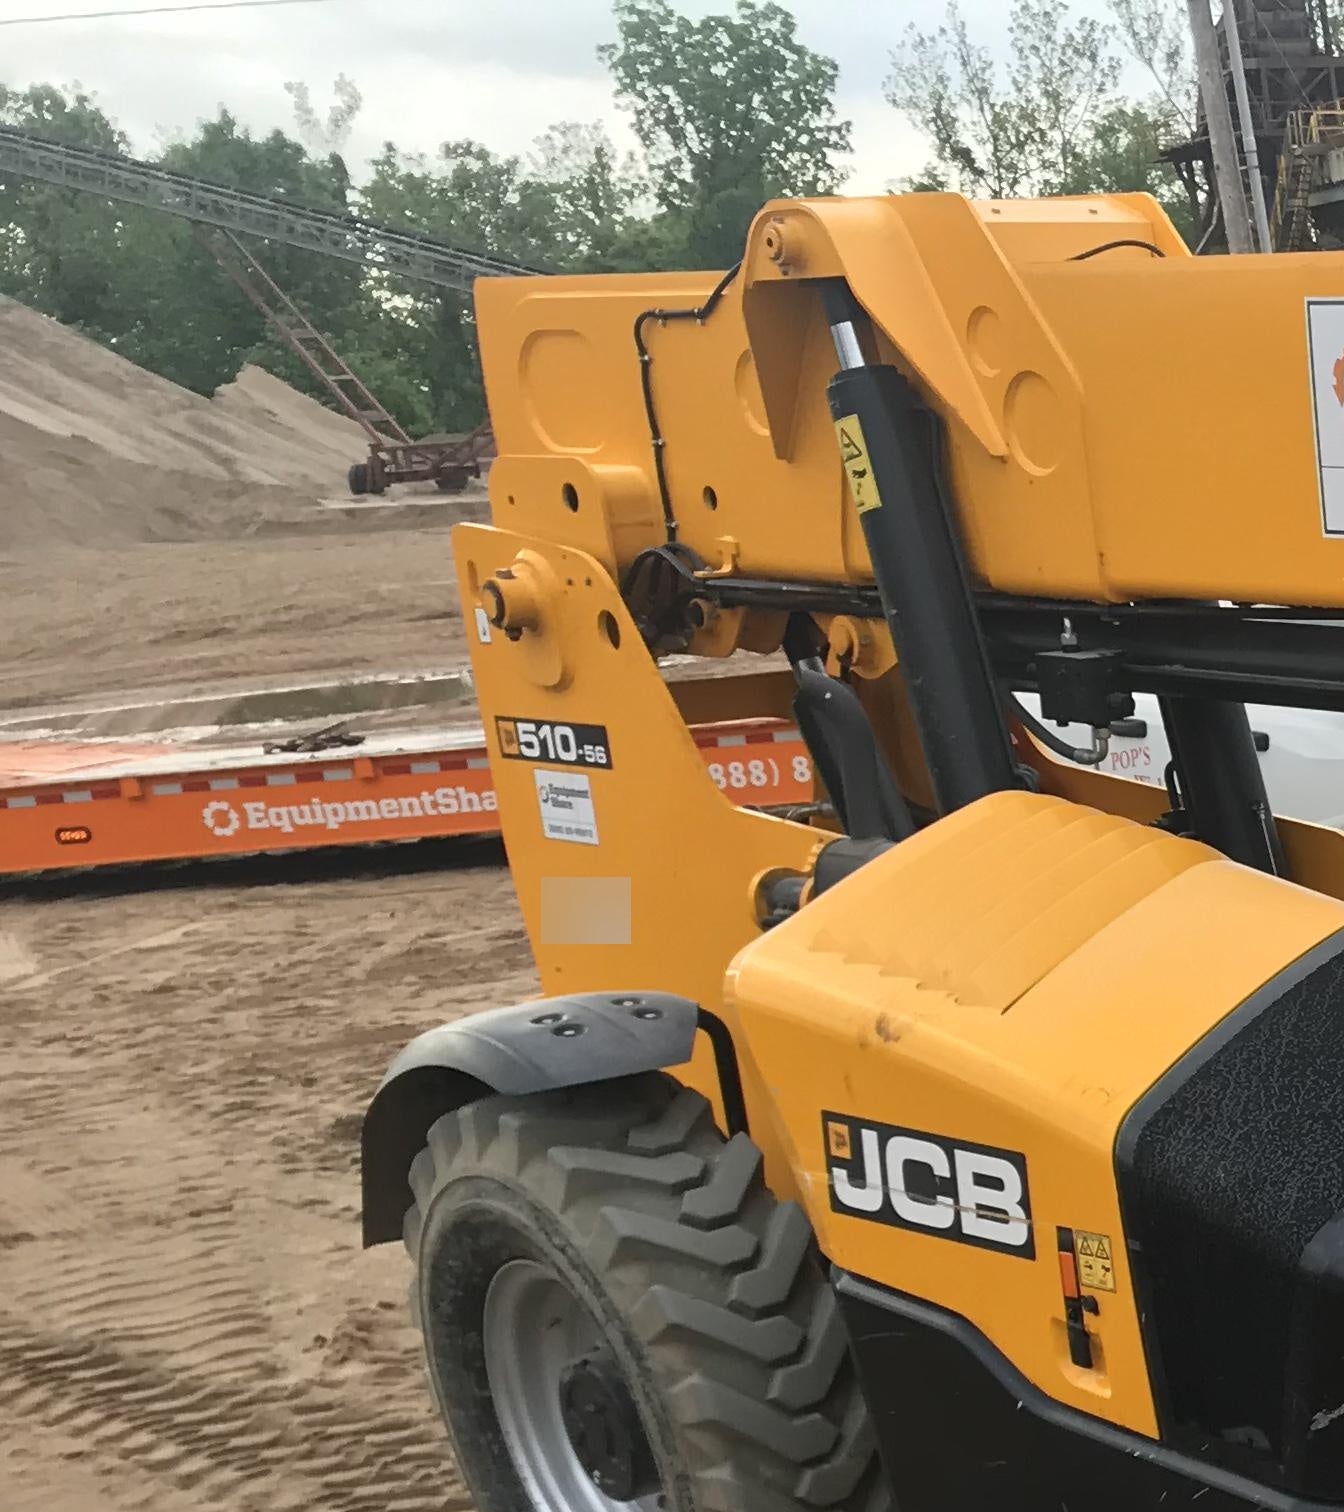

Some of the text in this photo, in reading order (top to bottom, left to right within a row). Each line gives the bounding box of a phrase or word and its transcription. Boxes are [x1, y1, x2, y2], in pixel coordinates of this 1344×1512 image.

[1110, 746, 1151, 771] POP'S
[243, 786, 497, 832] EquipmentSha
[832, 1128, 1030, 1246] JCB
